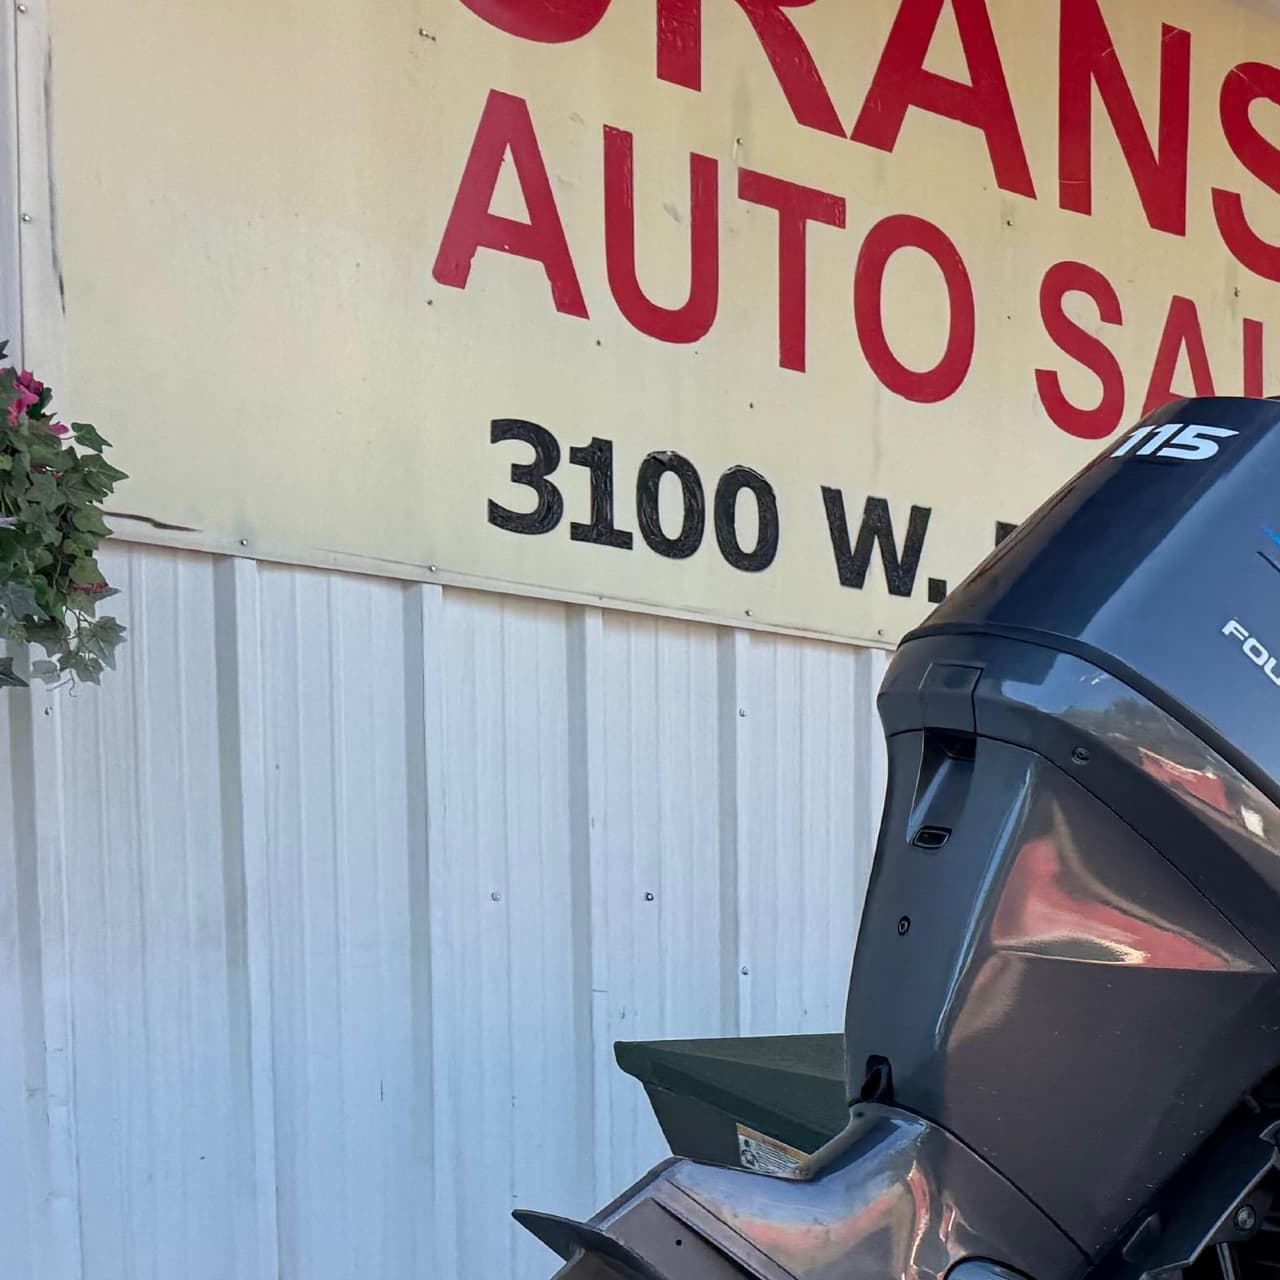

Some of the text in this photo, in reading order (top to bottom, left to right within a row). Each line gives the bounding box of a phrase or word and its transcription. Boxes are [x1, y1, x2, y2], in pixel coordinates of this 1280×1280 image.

[432, 89, 975, 404] AUTO
[487, 419, 947, 604] 3100 W.
[1110, 423, 1240, 461] 115
